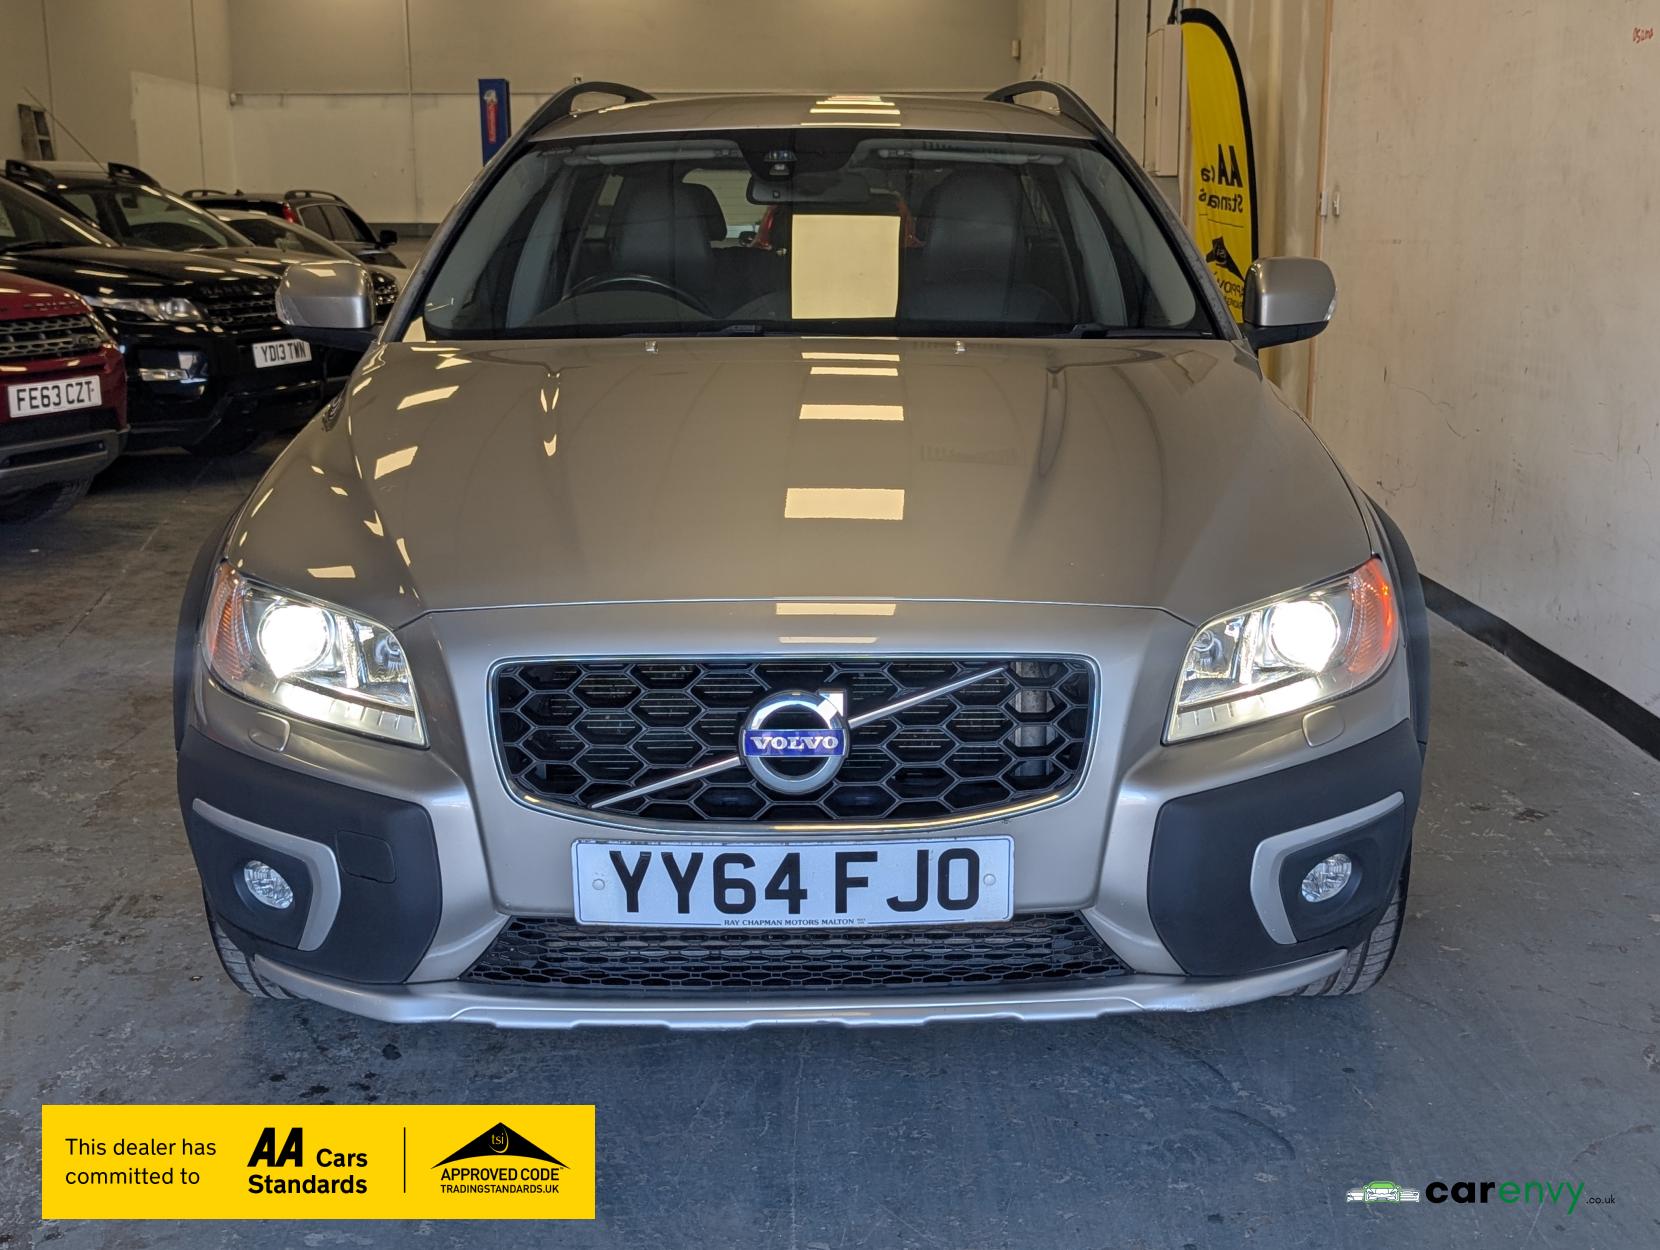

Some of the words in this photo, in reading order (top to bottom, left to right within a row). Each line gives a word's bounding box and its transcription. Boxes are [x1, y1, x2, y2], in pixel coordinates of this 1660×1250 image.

[261, 344, 287, 363] YD13
[287, 341, 307, 360] TWN
[16, 385, 61, 411] FE63
[65, 380, 92, 404] CZT
[750, 736, 839, 750] VOLVO
[608, 850, 808, 915] YY64
[834, 847, 980, 914] FJO
